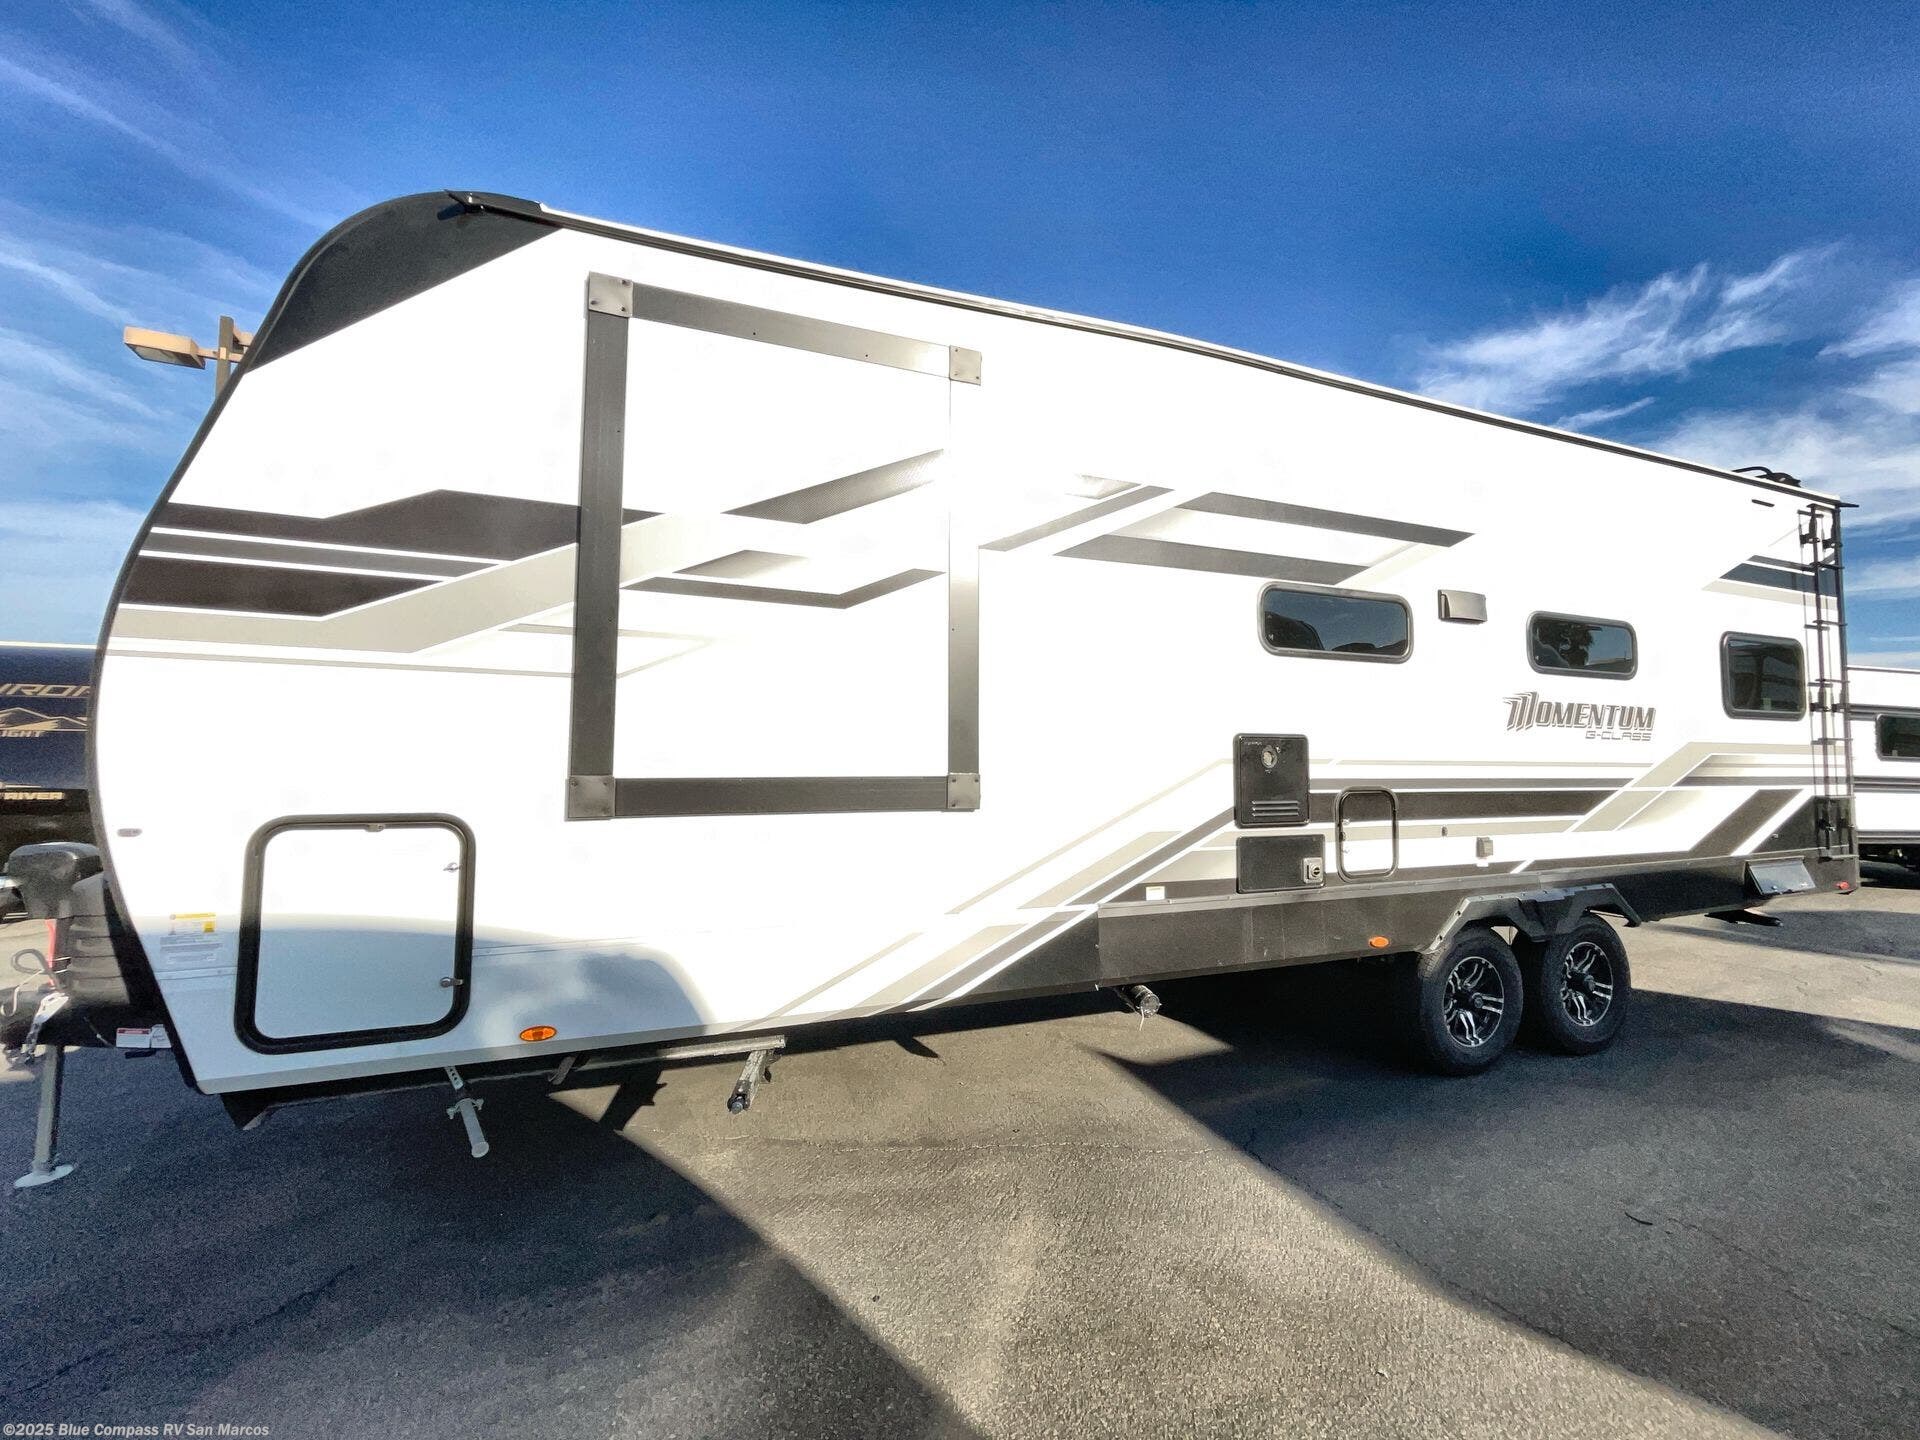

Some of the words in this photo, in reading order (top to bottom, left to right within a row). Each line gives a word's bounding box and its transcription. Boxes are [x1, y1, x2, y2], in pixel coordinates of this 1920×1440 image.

[1503, 691, 1656, 731] MOMENTUM
[1585, 730, 1651, 741] G-CLASS
[4, 791, 64, 800] RIVER
